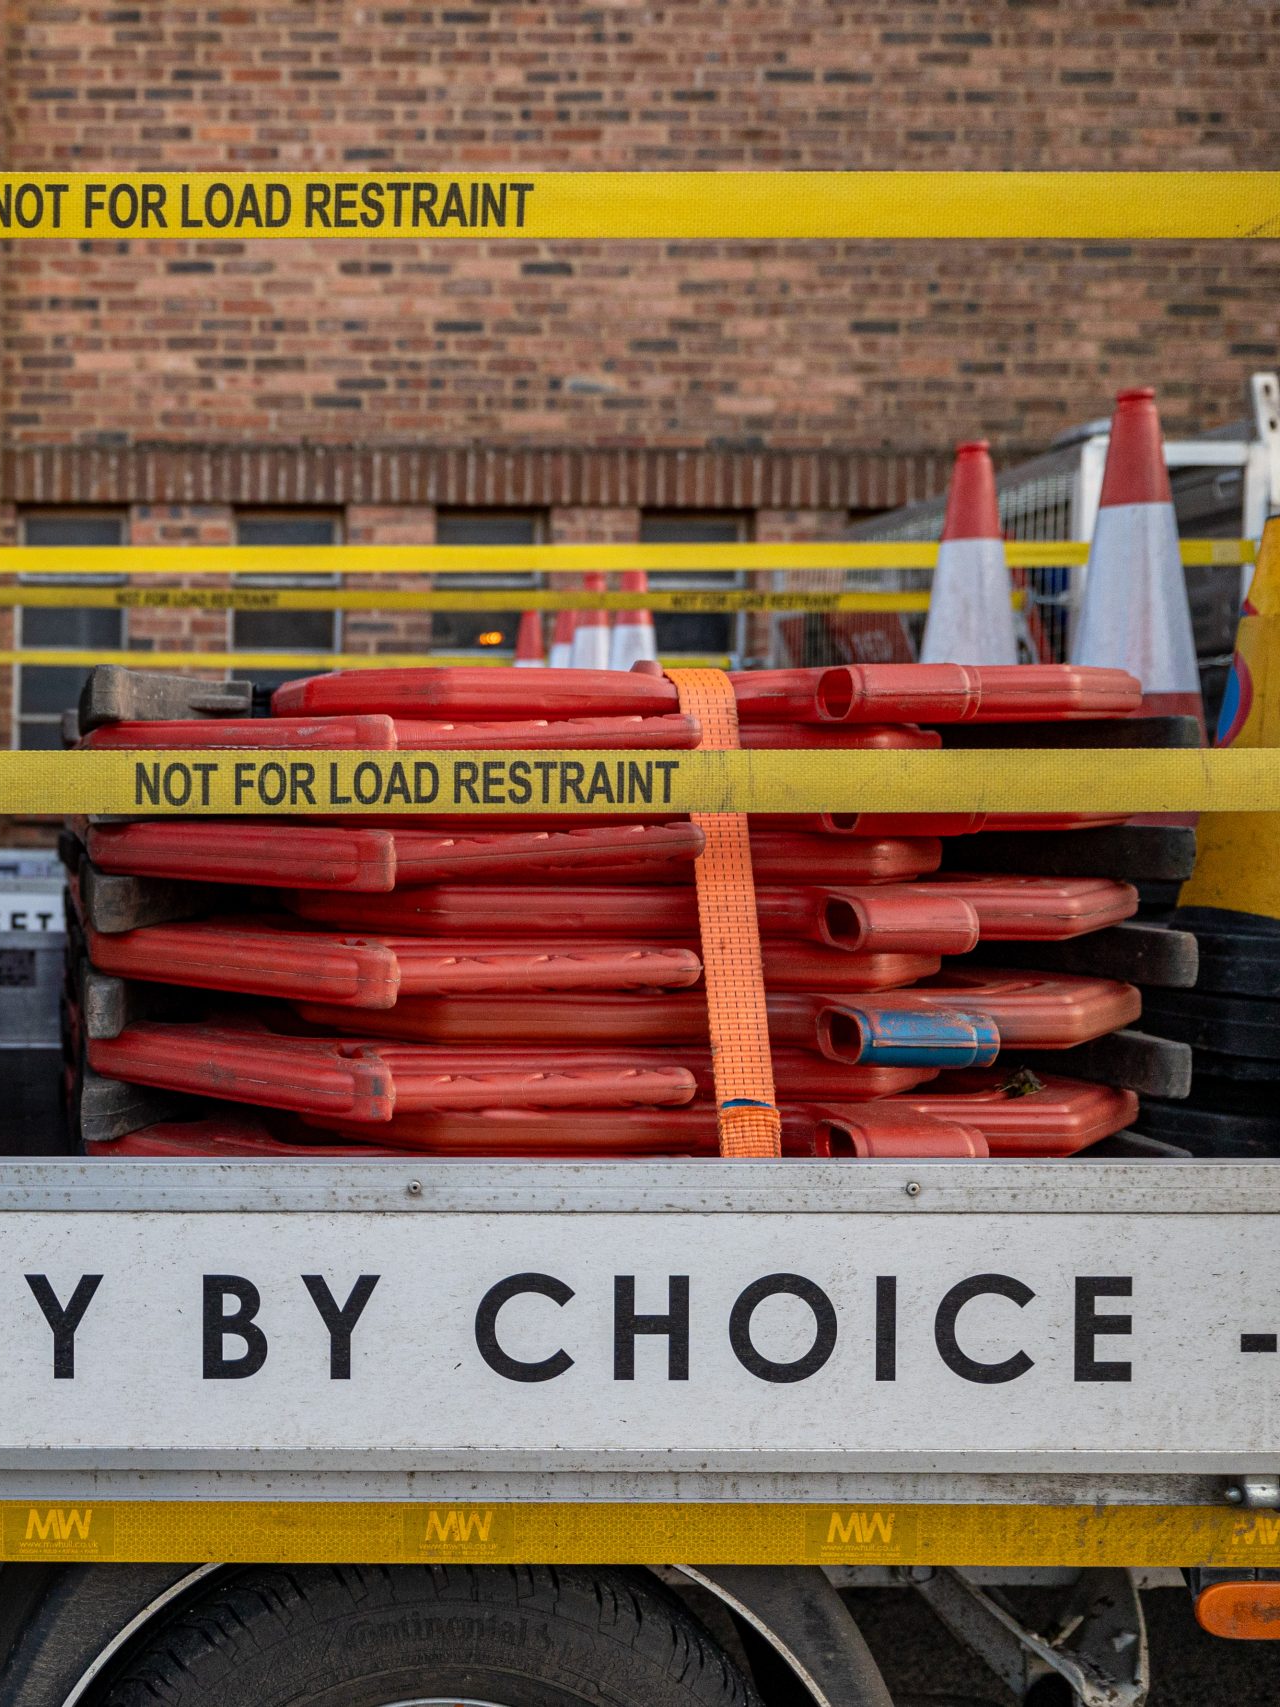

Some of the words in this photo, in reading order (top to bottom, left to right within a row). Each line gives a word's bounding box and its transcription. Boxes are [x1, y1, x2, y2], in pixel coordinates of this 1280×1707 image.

[86, 184, 167, 229] FOR
[181, 183, 291, 228] LOAD
[305, 183, 534, 228] RESTRAINT
[136, 763, 218, 807] NOT
[234, 762, 316, 806] FOR
[329, 761, 439, 805] LOAD
[453, 761, 680, 805] RESTRAINT
[203, 1275, 380, 1380] BY
[475, 1273, 1132, 1384] CHOICE
[25, 1508, 93, 1540] MW
[425, 1510, 493, 1541] MW
[827, 1512, 896, 1543] MW
